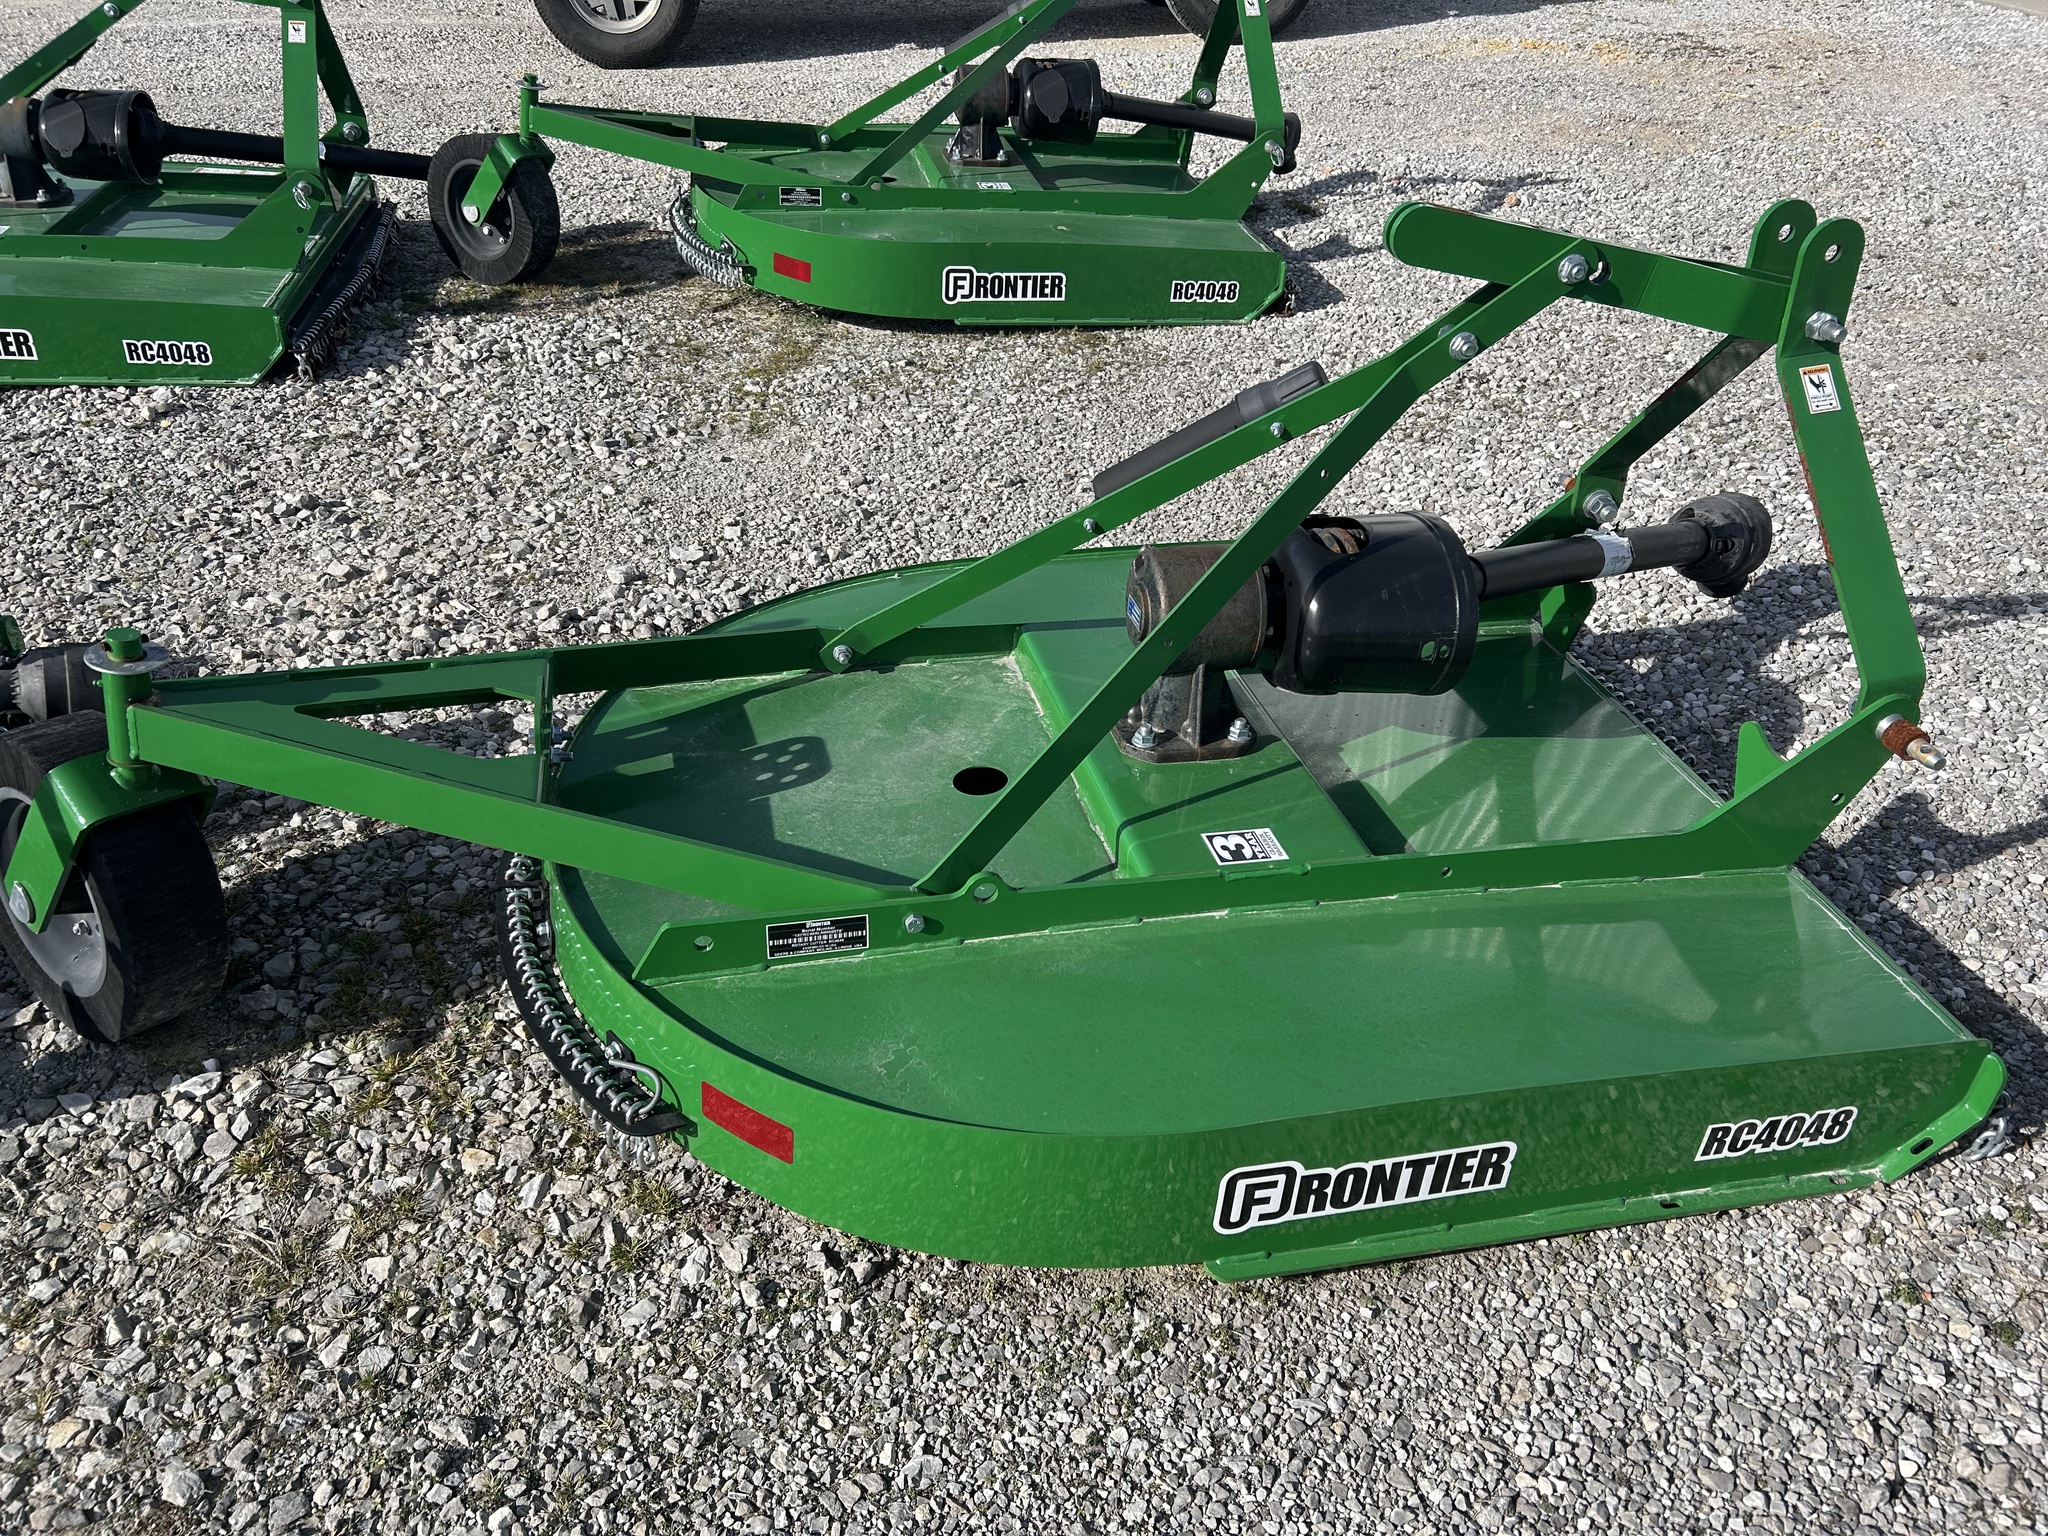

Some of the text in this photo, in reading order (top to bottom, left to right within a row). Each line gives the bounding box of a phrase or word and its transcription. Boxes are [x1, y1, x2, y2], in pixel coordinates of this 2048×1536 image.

[944, 268, 1065, 302] FRONTIER
[1172, 281, 1238, 301] RC4048
[0, 331, 35, 358] ER
[125, 341, 210, 364] RC4048
[1212, 834, 1254, 860] 3
[1243, 832, 1266, 859] YEAR
[1700, 1109, 1855, 1157] RC4048
[1218, 1145, 1512, 1230] FRONTIER
